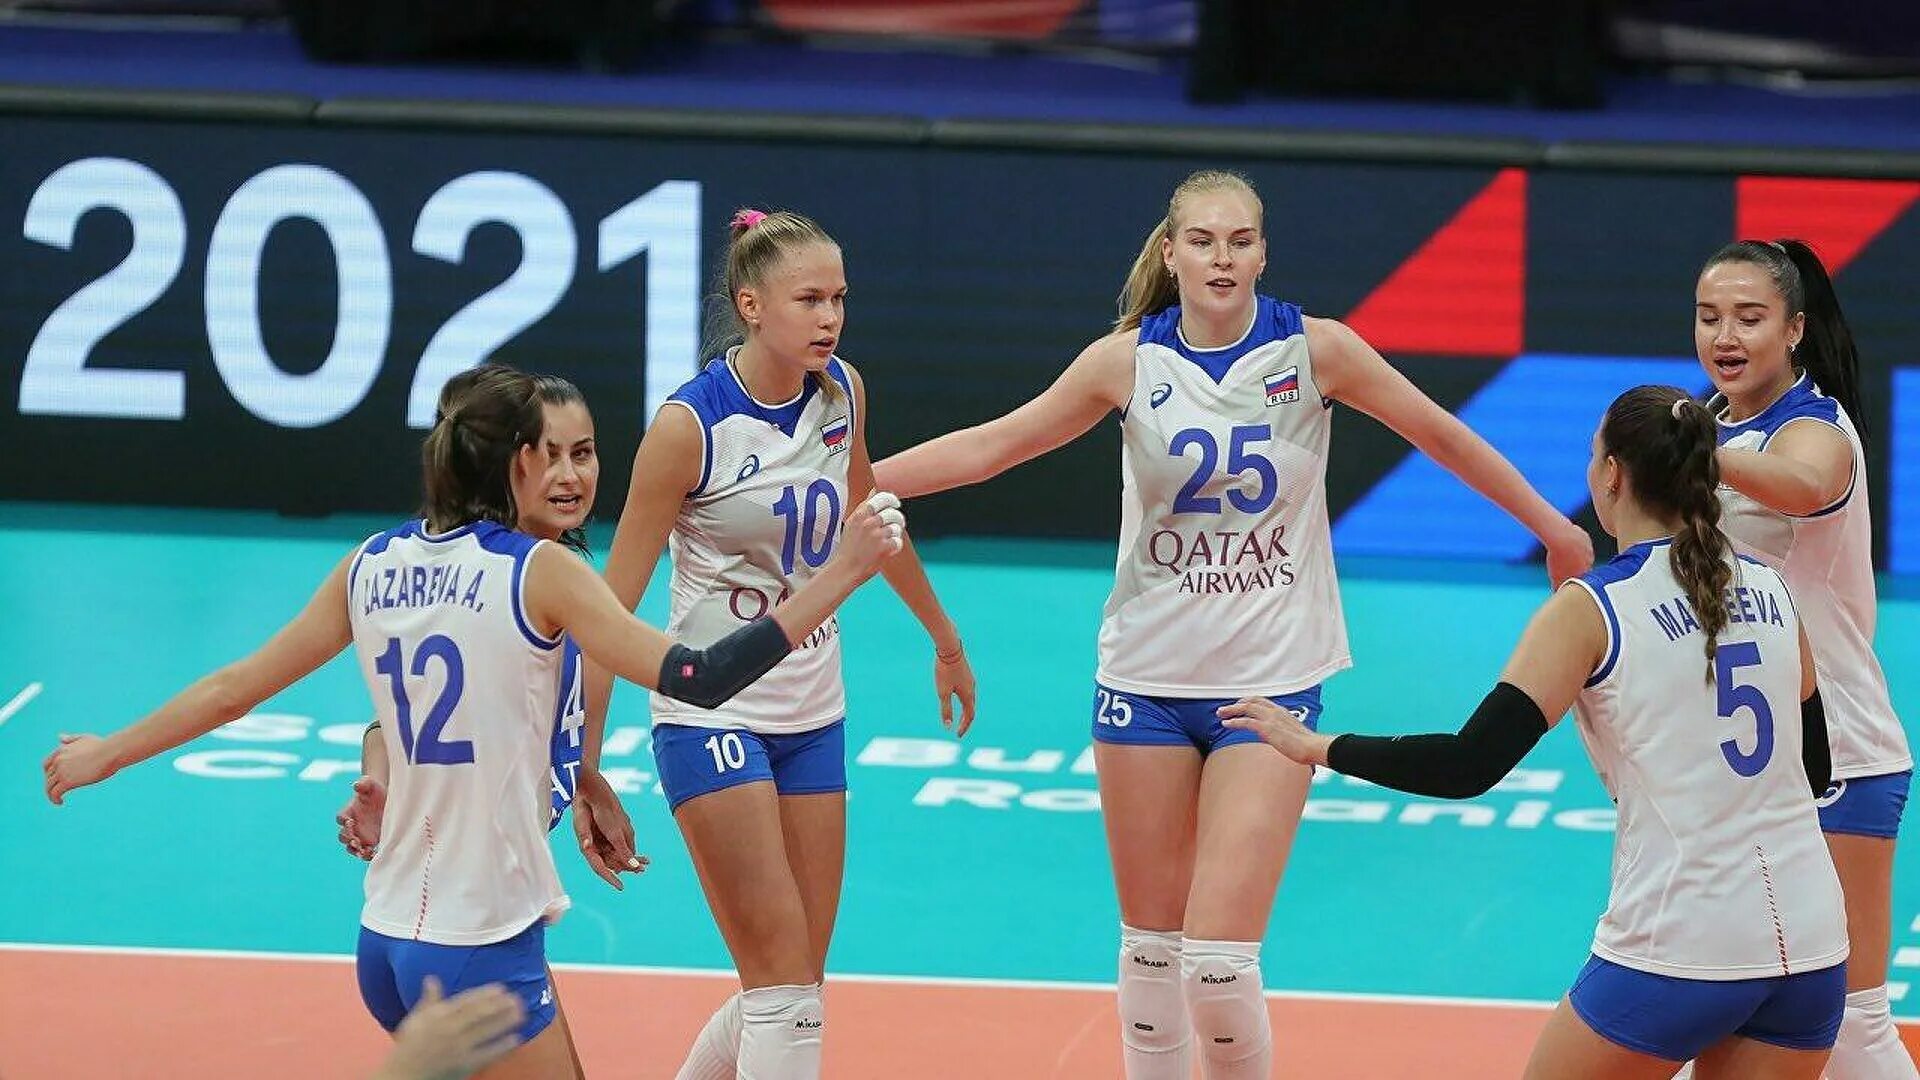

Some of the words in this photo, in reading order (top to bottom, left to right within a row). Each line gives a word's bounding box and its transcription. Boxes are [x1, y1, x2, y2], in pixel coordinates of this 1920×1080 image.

[18, 155, 702, 431] 2021
[1271, 391, 1294, 404] RUS
[1168, 424, 1278, 514] 25
[772, 479, 840, 575] 10
[1149, 525, 1289, 575] QATAR
[364, 563, 462, 615] LAZAREVA
[1178, 562, 1295, 594] AIRWAYS
[1650, 587, 1784, 641] MAEEVA
[375, 634, 475, 765] 12
[1098, 689, 1132, 727] 25
[1715, 641, 1774, 777] 5
[704, 732, 746, 774] 10
